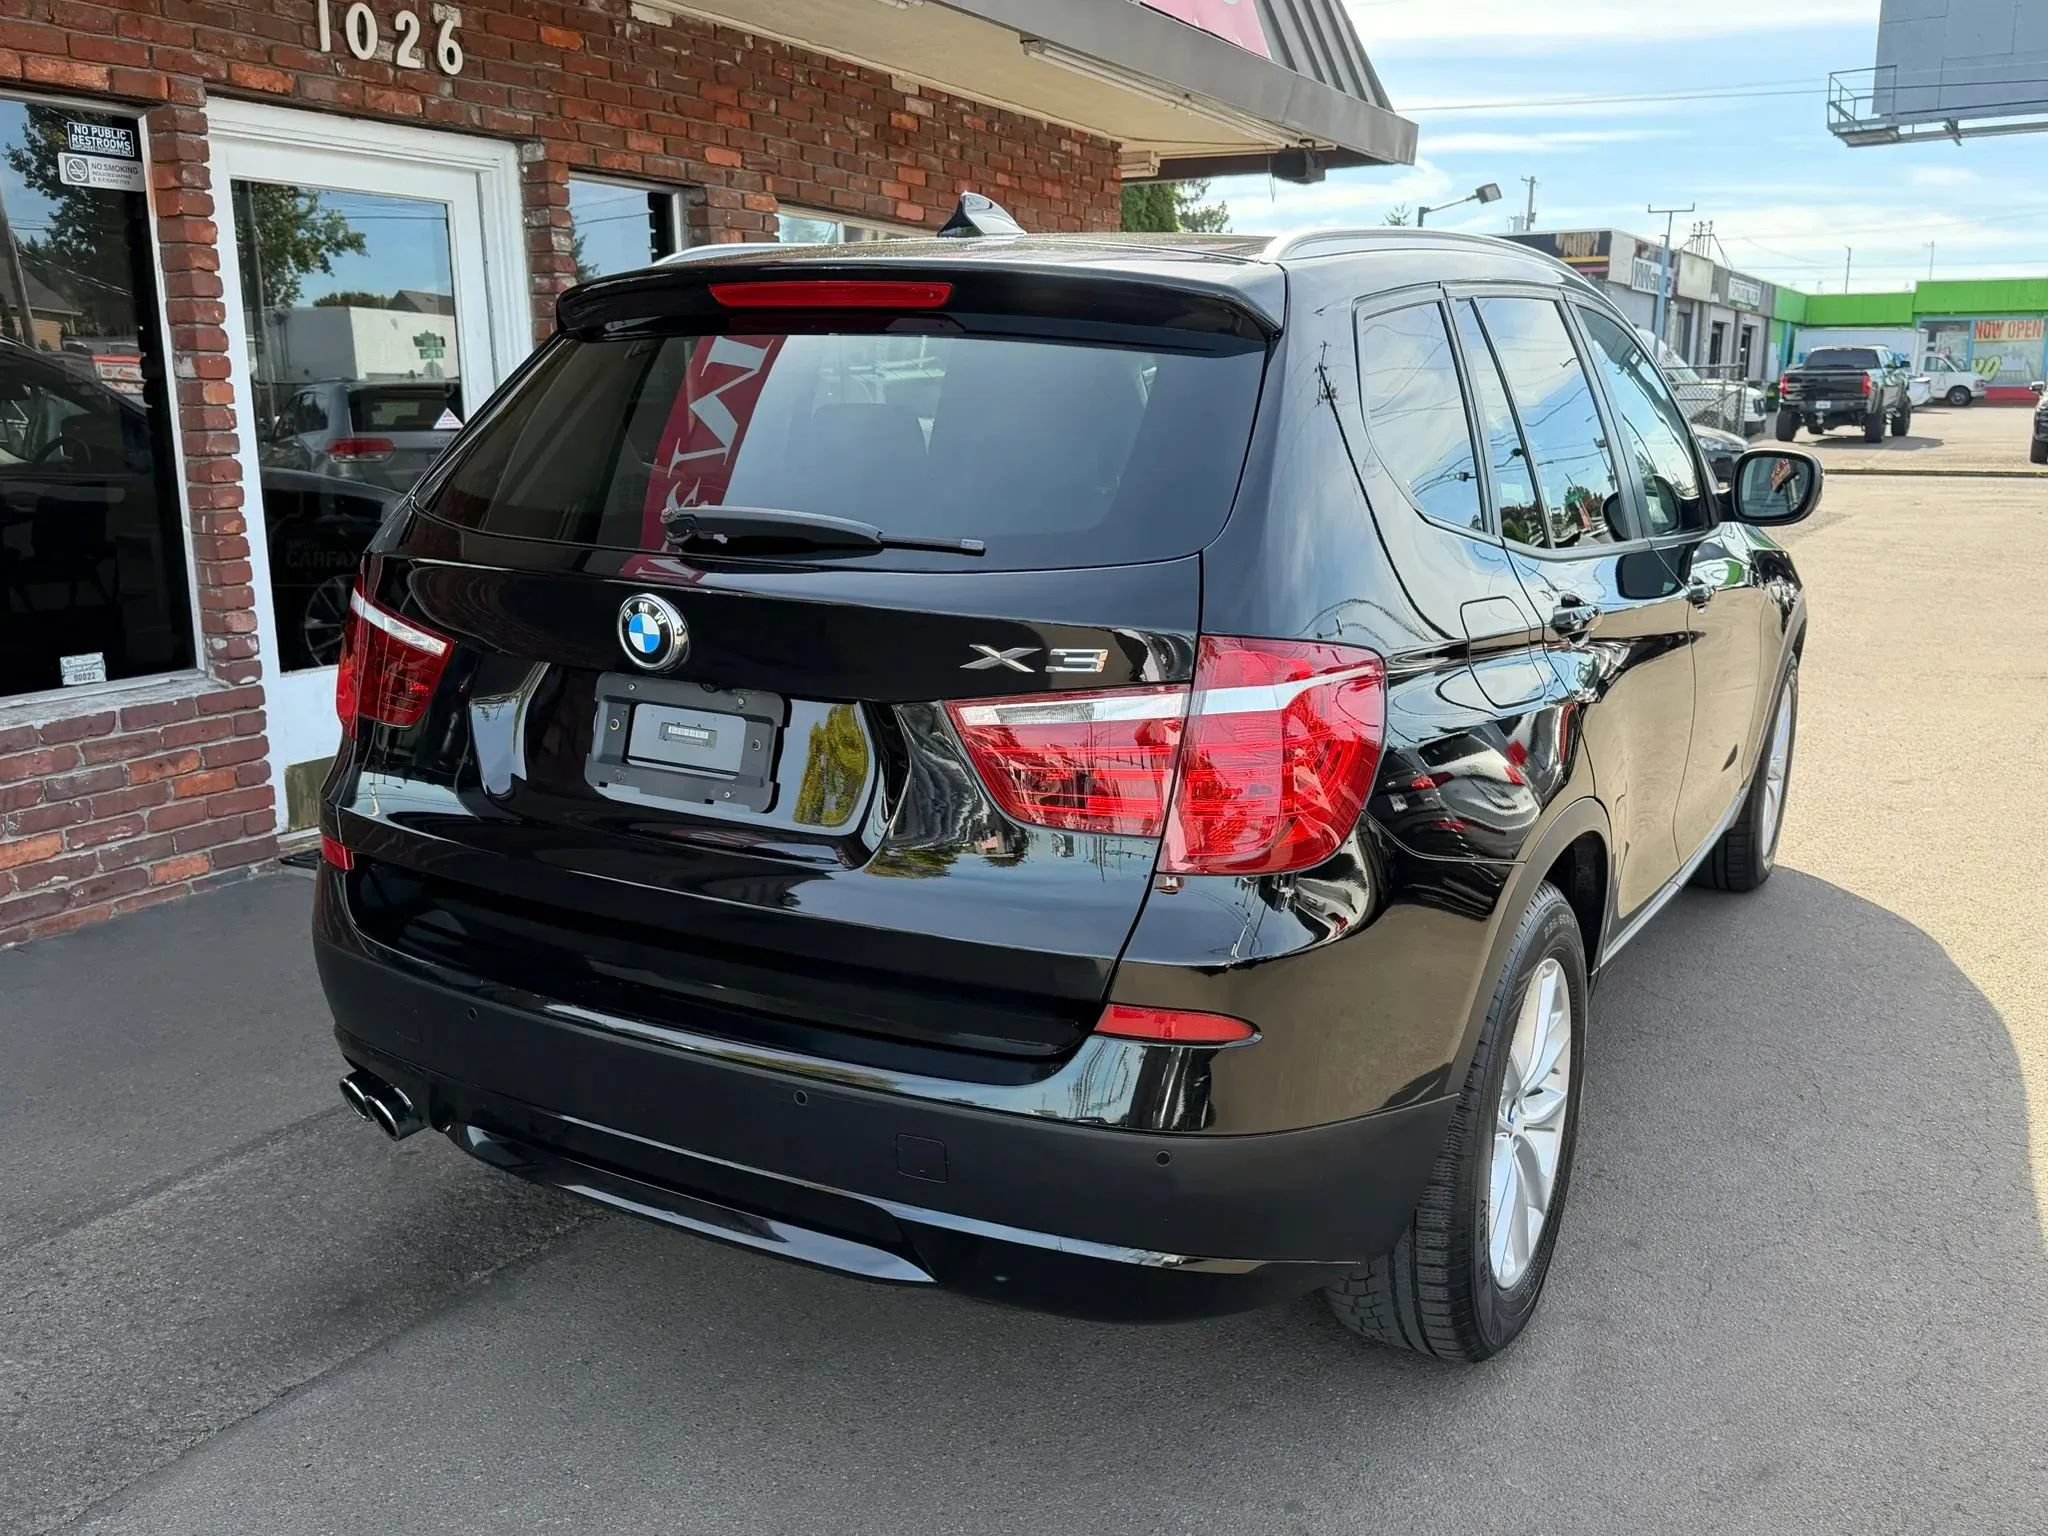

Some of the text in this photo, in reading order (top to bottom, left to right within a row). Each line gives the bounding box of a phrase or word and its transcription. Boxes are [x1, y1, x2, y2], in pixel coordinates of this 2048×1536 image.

[319, 0, 463, 75] 1026
[74, 124, 127, 140] NO PUBLIC
[71, 134, 131, 151] RESTROOMS
[91, 162, 139, 175] NO SMOKING
[1974, 319, 2041, 339] NOW OPEN
[285, 551, 360, 569] CARFAX
[624, 602, 667, 625] BMW
[959, 643, 1109, 673] X3
